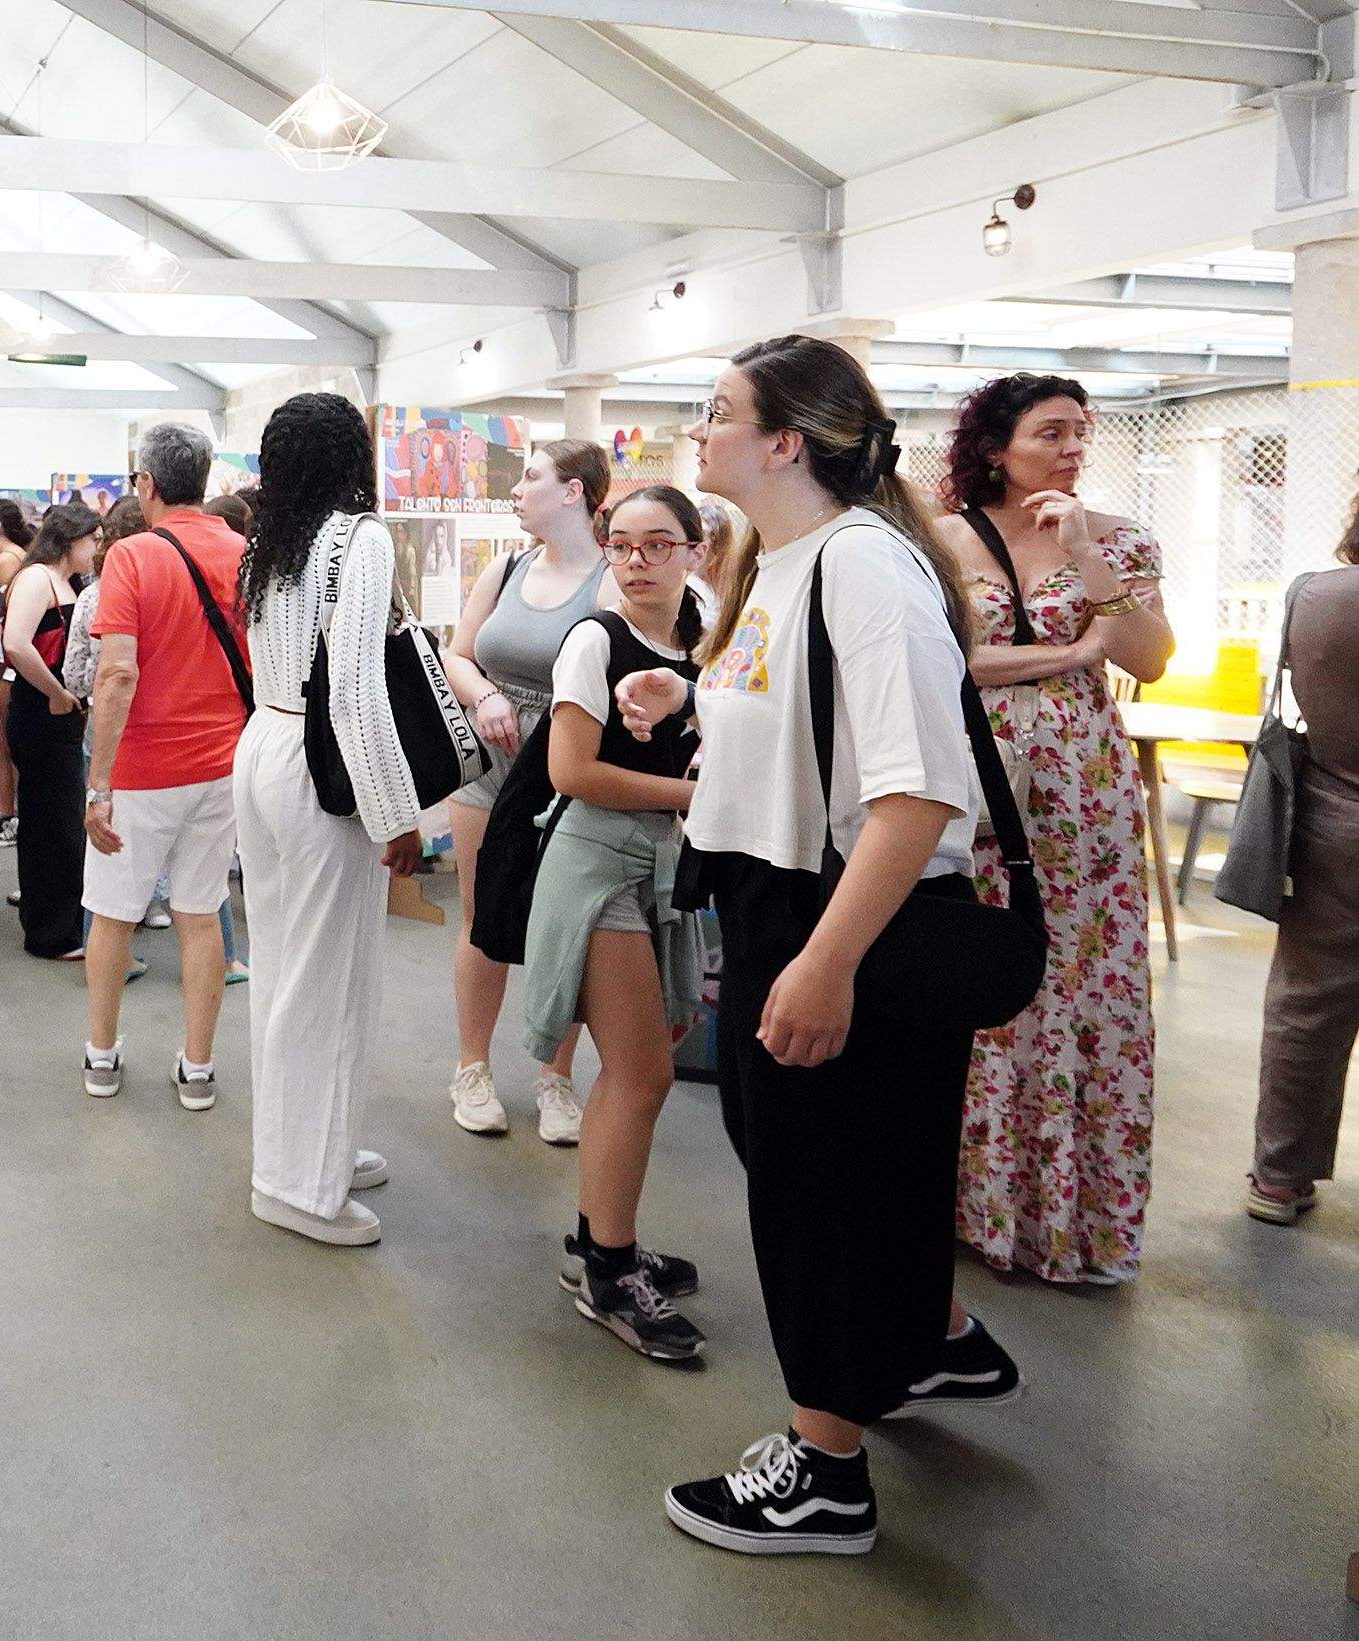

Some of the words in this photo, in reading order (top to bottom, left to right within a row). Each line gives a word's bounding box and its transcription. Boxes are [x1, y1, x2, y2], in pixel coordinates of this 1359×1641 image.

[332, 542, 343, 552] Y
[324, 554, 342, 603] BIMBA
[423, 654, 450, 700] BIMBA
[444, 700, 456, 712] Y
[449, 716, 476, 761] LOLA
